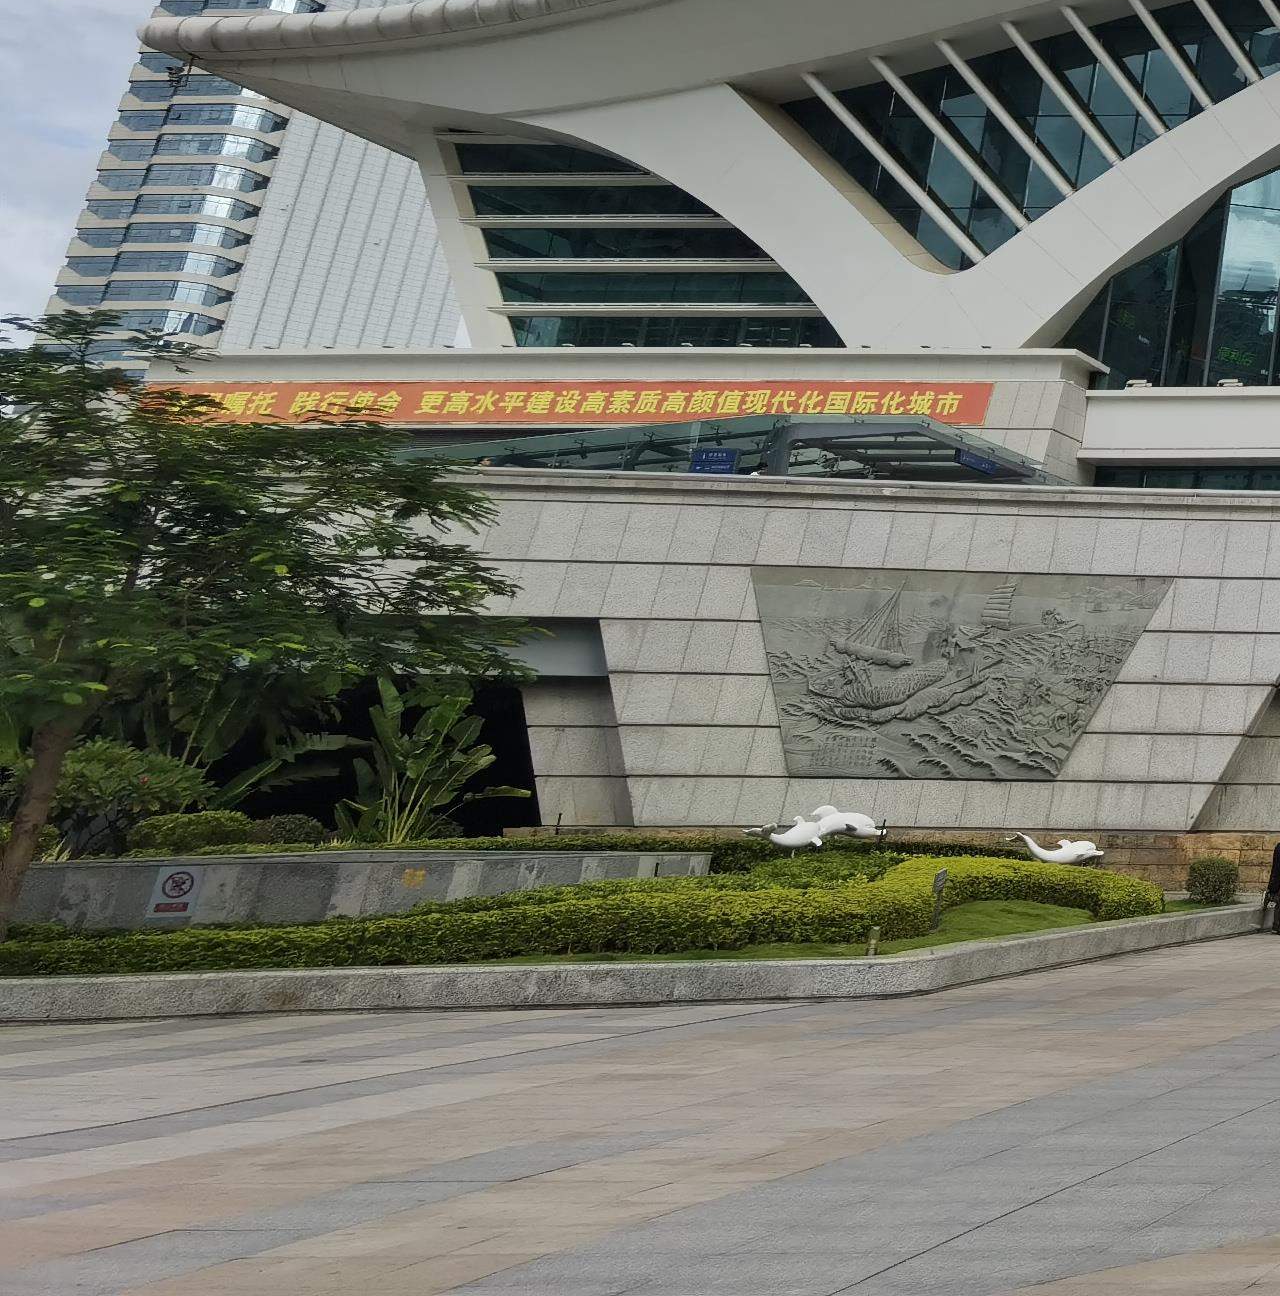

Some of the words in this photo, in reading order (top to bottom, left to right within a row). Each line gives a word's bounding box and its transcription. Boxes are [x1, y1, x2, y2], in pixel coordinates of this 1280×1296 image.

[414, 389, 963, 416] 更高水平建设高素质高颜值现代化国际化城市
